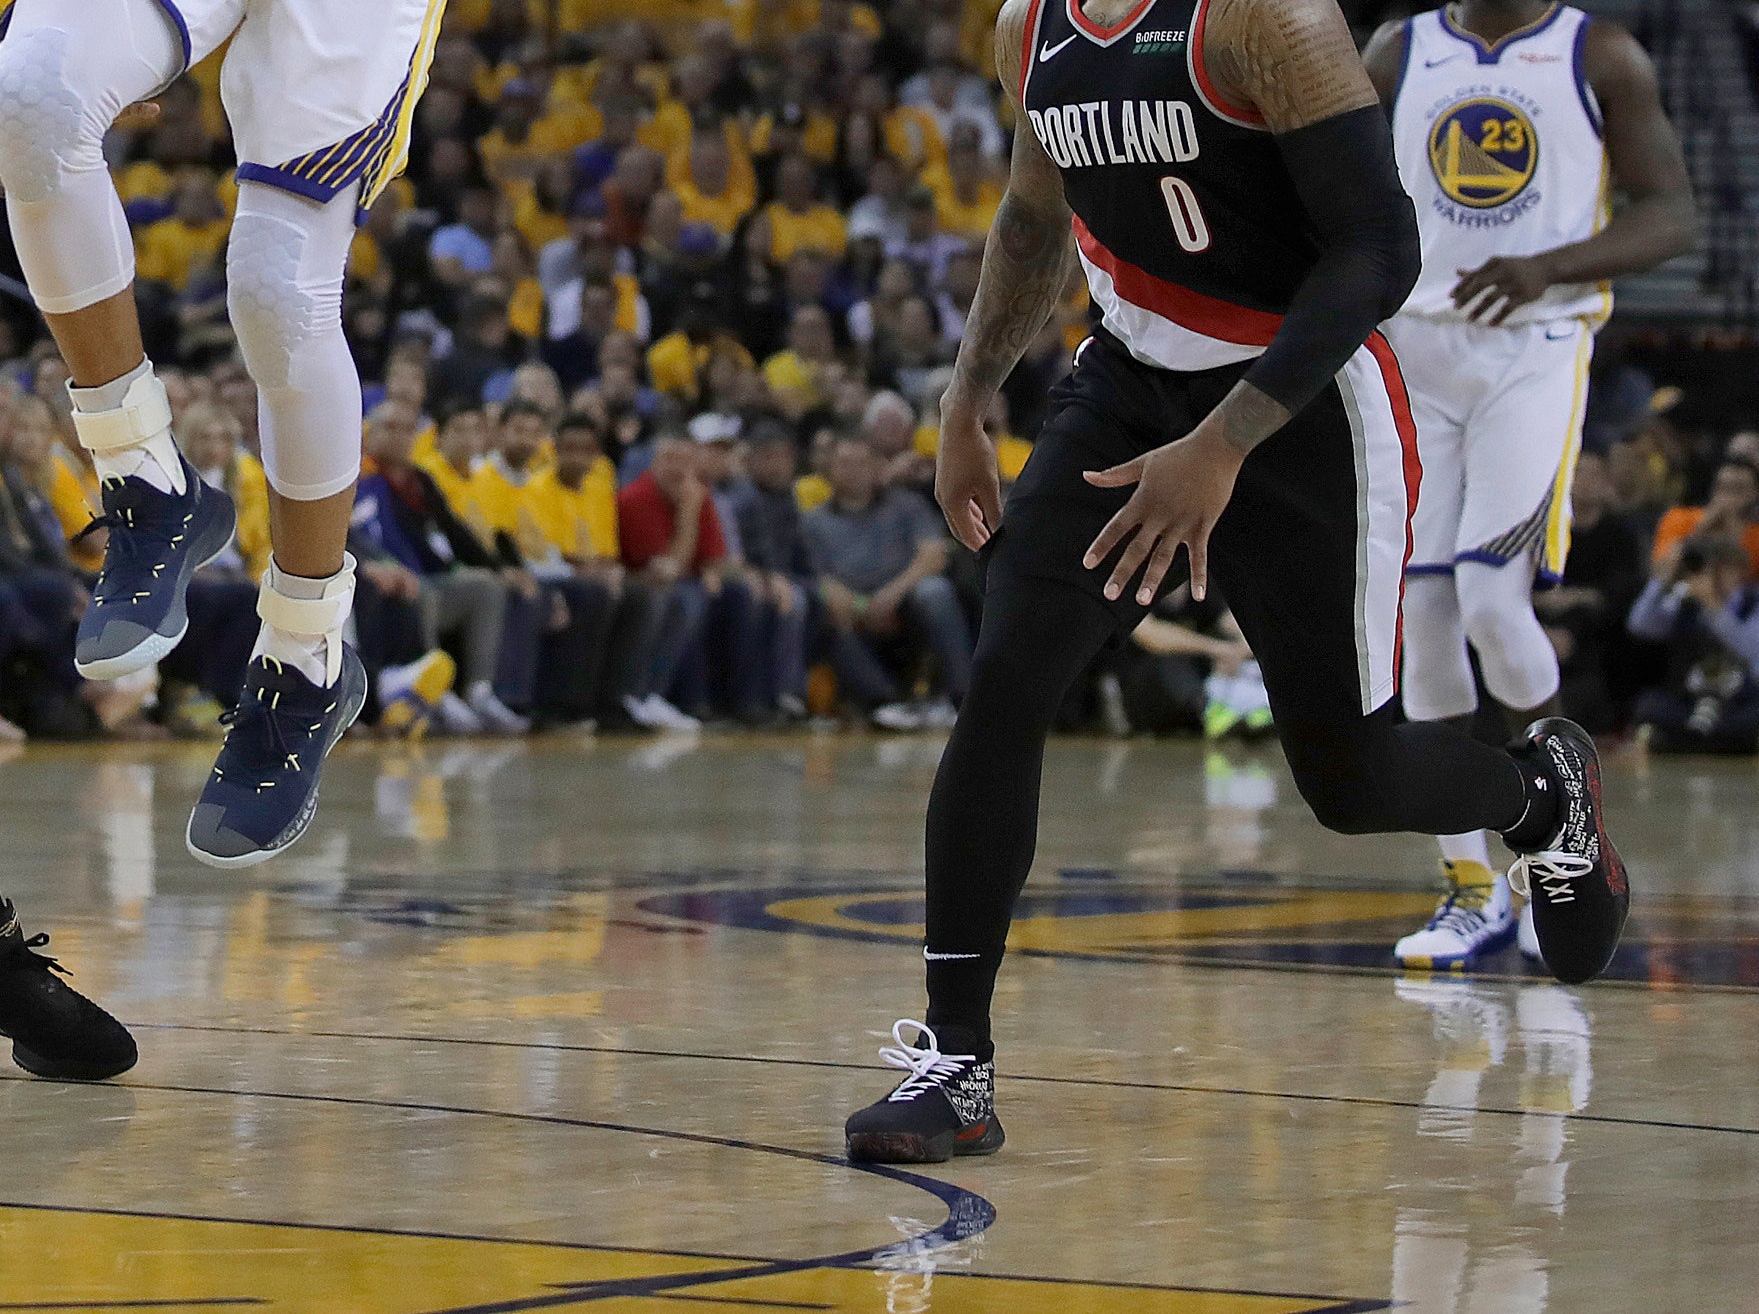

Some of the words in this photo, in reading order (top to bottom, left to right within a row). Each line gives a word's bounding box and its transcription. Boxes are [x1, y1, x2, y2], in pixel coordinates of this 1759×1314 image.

[1027, 100, 1200, 168] PORTLAND
[1481, 119, 1525, 152] 23
[1160, 176, 1210, 253] 0
